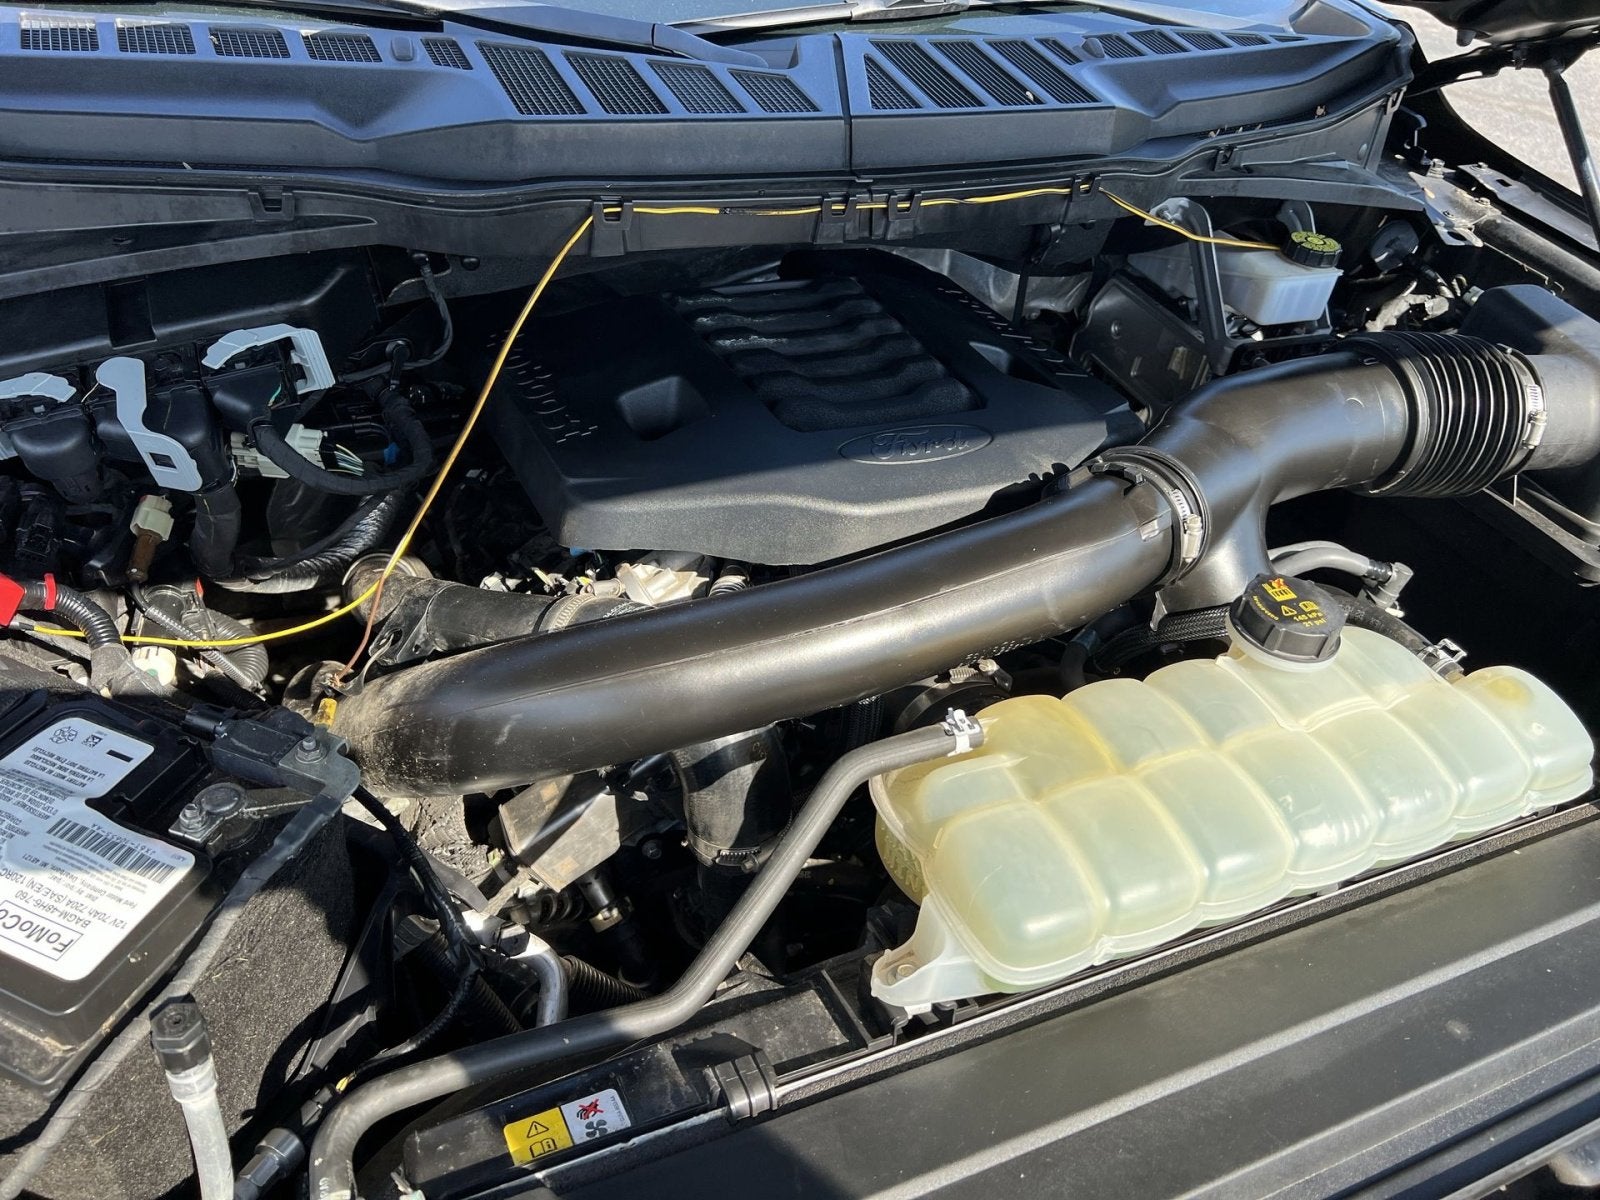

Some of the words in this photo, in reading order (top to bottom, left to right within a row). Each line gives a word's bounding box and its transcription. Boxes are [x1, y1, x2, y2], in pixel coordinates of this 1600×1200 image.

[871, 427, 969, 460] Ford
[15, 890, 91, 927] BAGM-48H6-760
[65, 899, 88, 912] 720A
[87, 908, 110, 921] 70Ah
[110, 918, 127, 928] 12V
